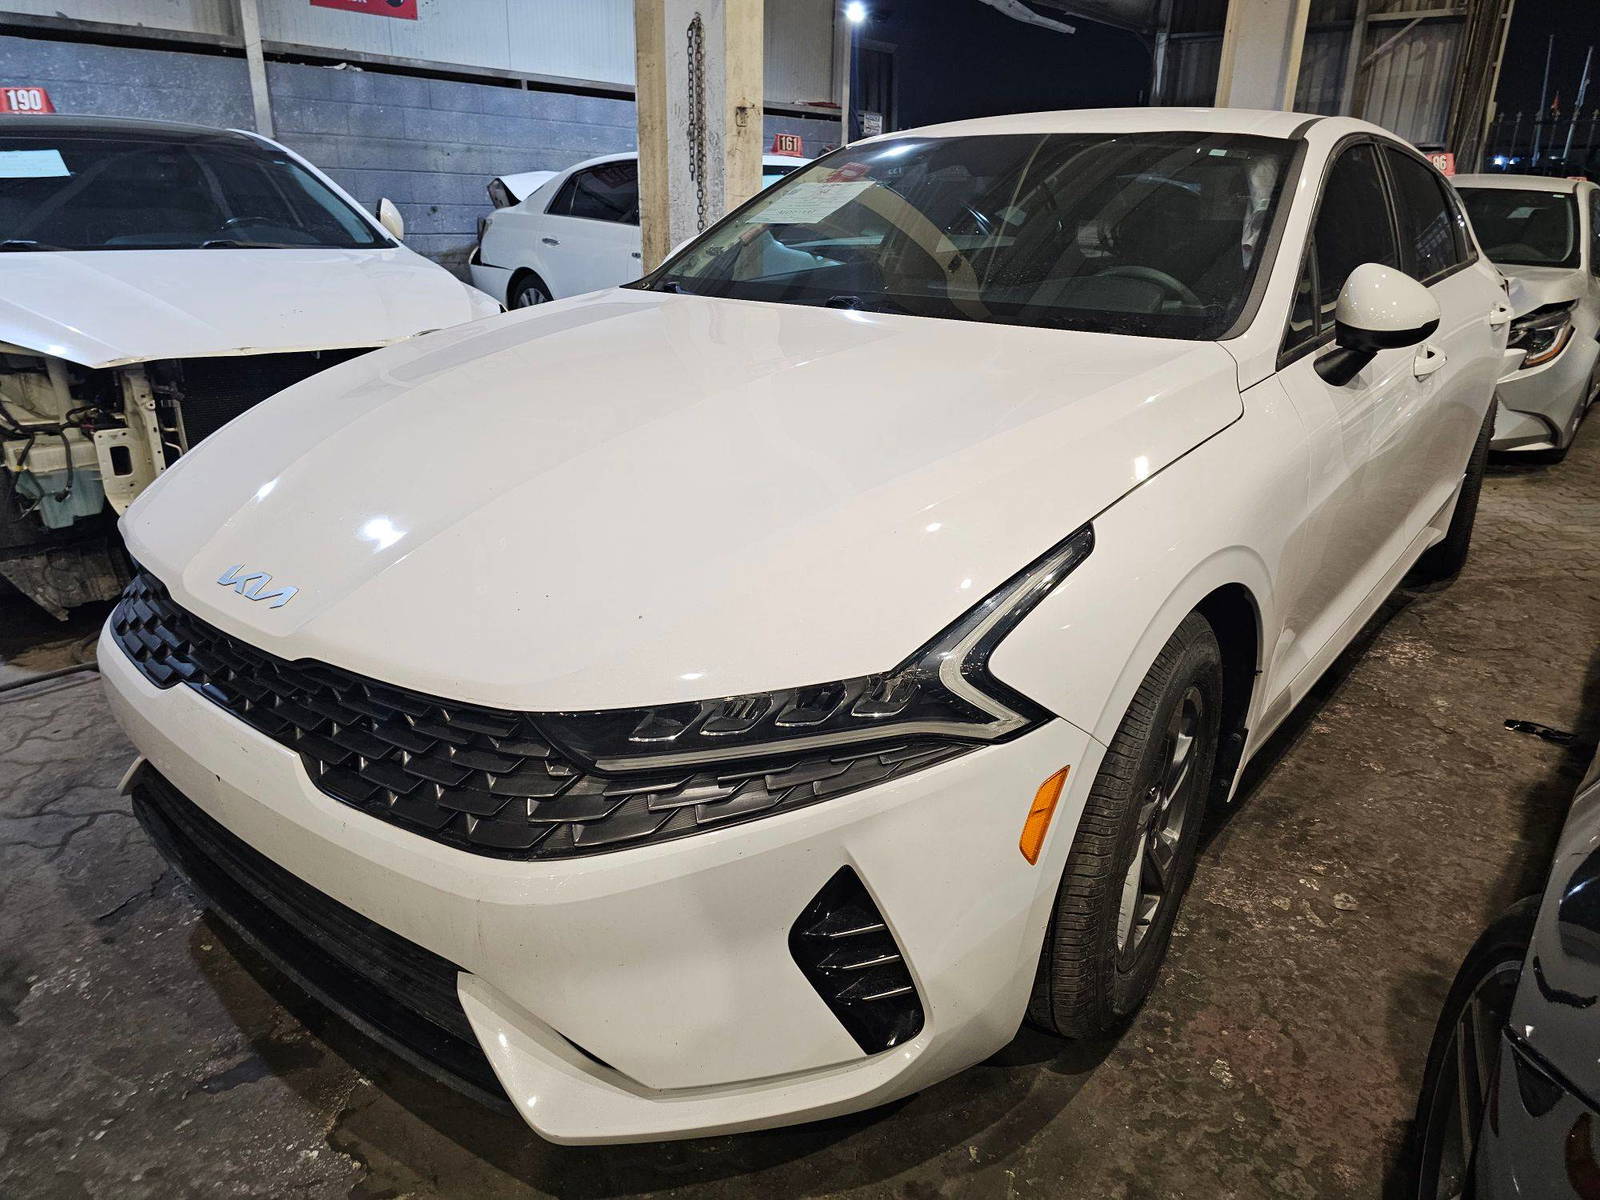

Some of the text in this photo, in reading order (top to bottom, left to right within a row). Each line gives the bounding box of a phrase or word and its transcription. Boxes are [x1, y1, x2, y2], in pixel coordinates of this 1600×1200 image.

[7, 89, 42, 111] 190
[781, 135, 798, 152] 161
[216, 561, 299, 609] KIA
